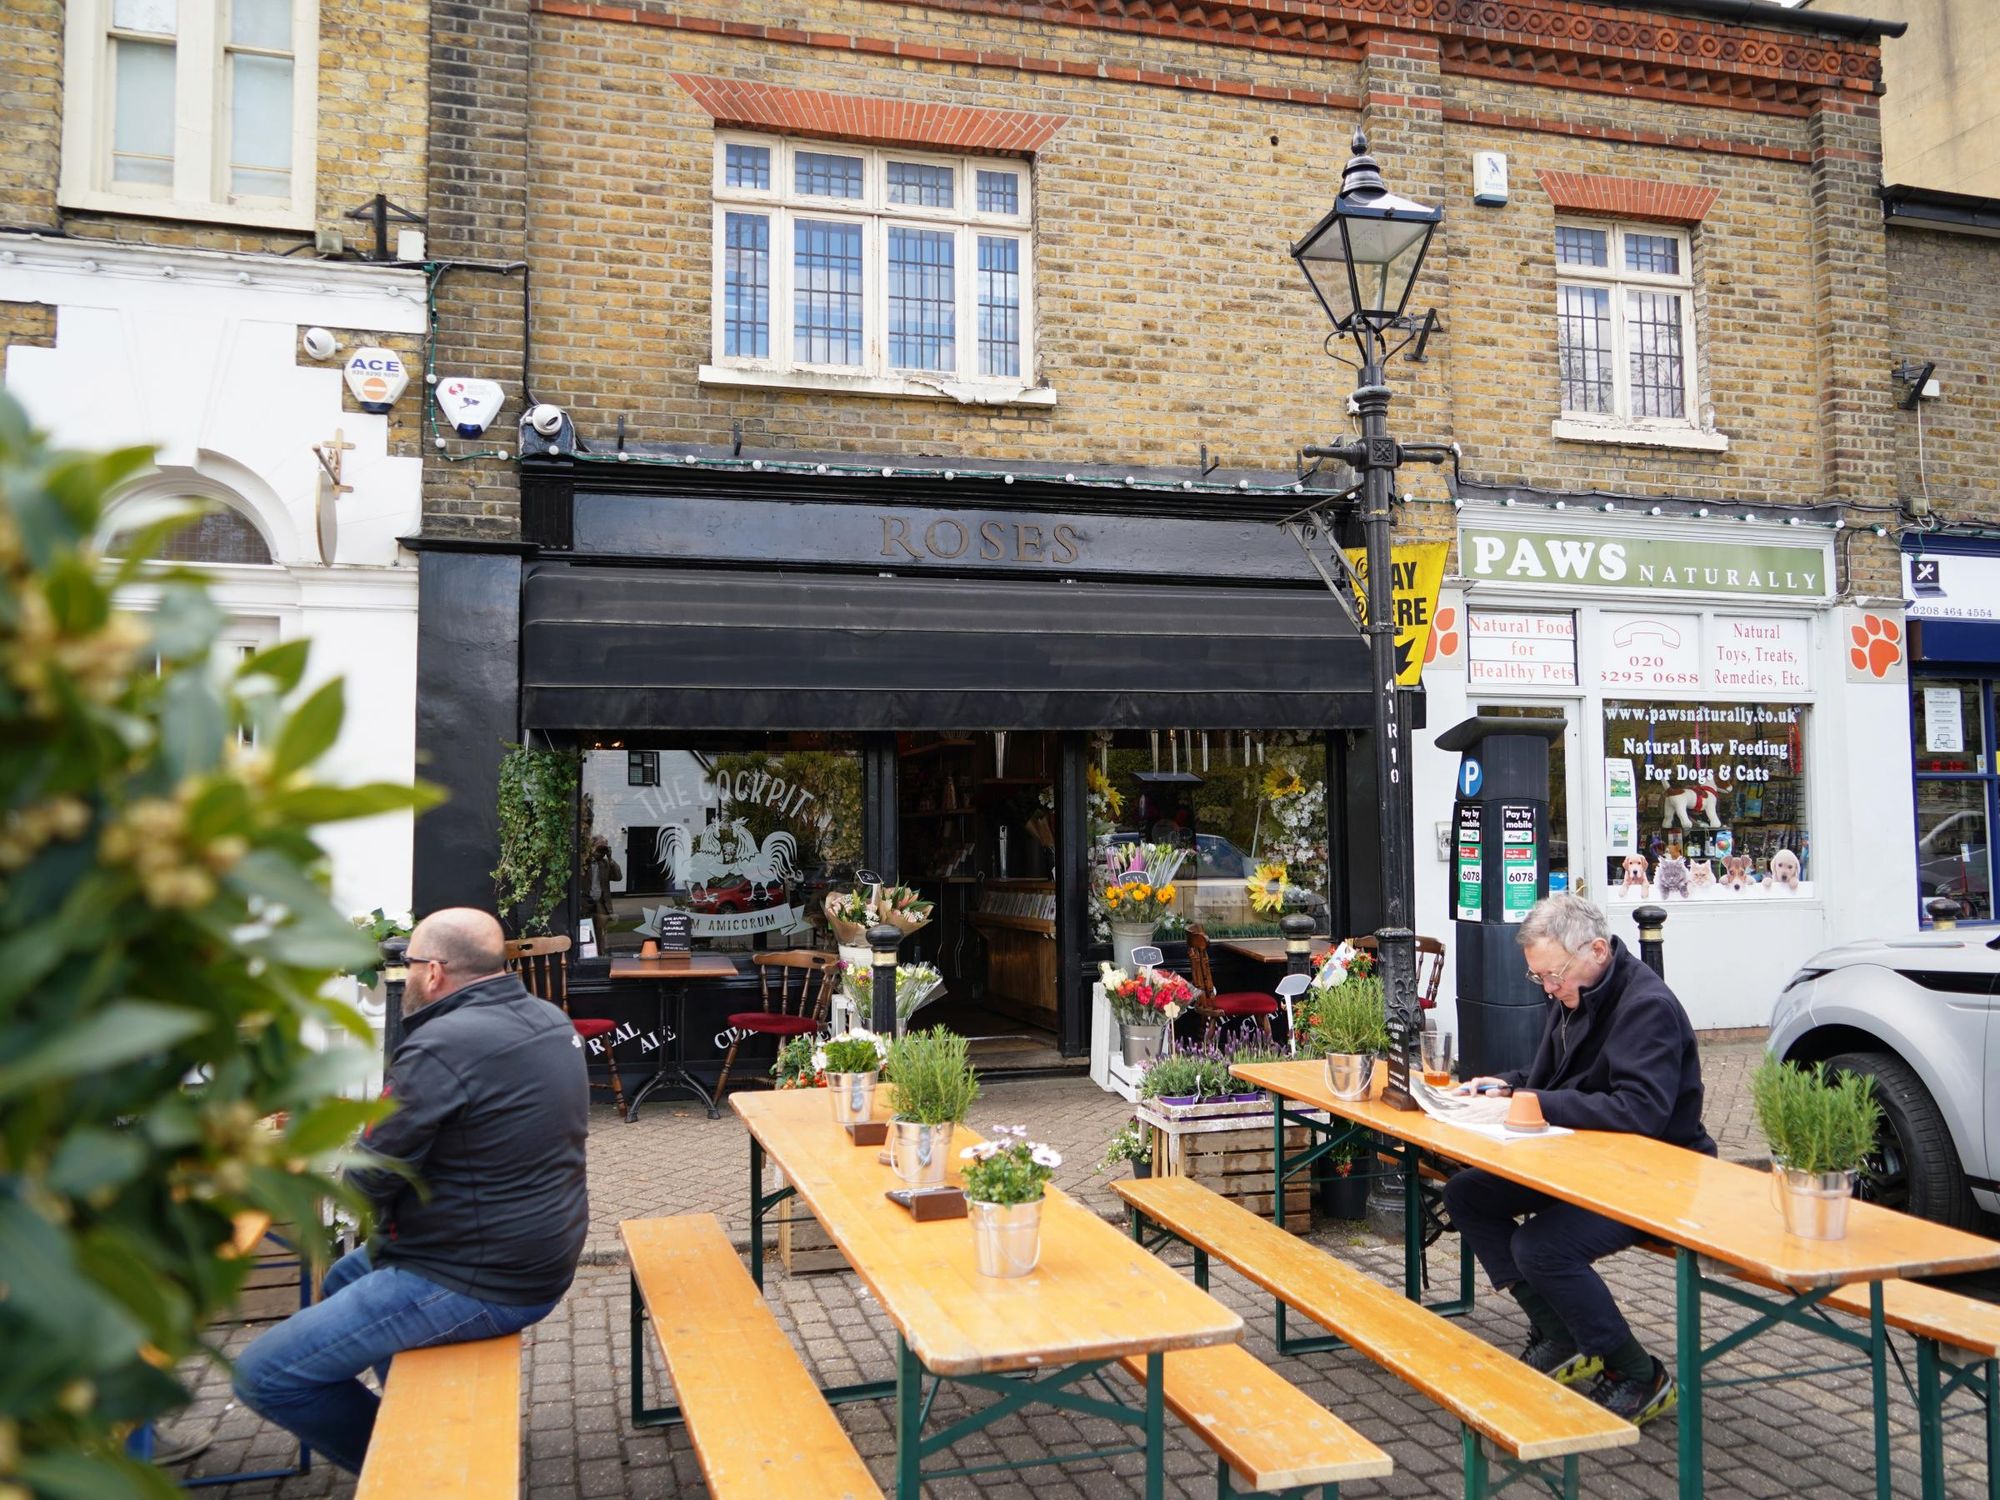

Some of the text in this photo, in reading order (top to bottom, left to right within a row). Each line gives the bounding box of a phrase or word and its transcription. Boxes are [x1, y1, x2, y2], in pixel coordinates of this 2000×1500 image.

[351, 358, 400, 373] ACE
[879, 514, 1079, 564] ROSES
[1472, 536, 1817, 590] PAWS NATURALLY
[1391, 561, 1417, 590] AY
[1392, 597, 1428, 627] RE
[1912, 606, 1993, 617] 0208 464 4554
[1469, 616, 1573, 635] Natural Food
[1734, 623, 1781, 639] Natural
[1511, 640, 1536, 656] for
[1716, 645, 1798, 665] Toys, Treats,
[1629, 655, 1664, 667] 020
[1472, 662, 1574, 683] Healthy Pets
[1653, 672, 1699, 684] 0688
[1714, 668, 1805, 687] Remedies, Etc.
[1605, 705, 1797, 726] www.pawsnaturally.co.uk
[1623, 738, 1789, 760] Natural Raw Feeding
[1465, 760, 1480, 795] P
[1645, 764, 1770, 784] For Dogs & Cats
[633, 769, 815, 820] THE COCKPIT
[1461, 809, 1480, 820] Pay by
[1461, 820, 1481, 828] mobile
[1505, 810, 1532, 820] Pay by
[1505, 820, 1533, 829] mobile
[1462, 870, 1481, 882] 6078
[1508, 872, 1534, 882] 6078
[708, 914, 776, 931] AMICORUM
[586, 1021, 641, 1056] REAL
[714, 1026, 759, 1050] CID
